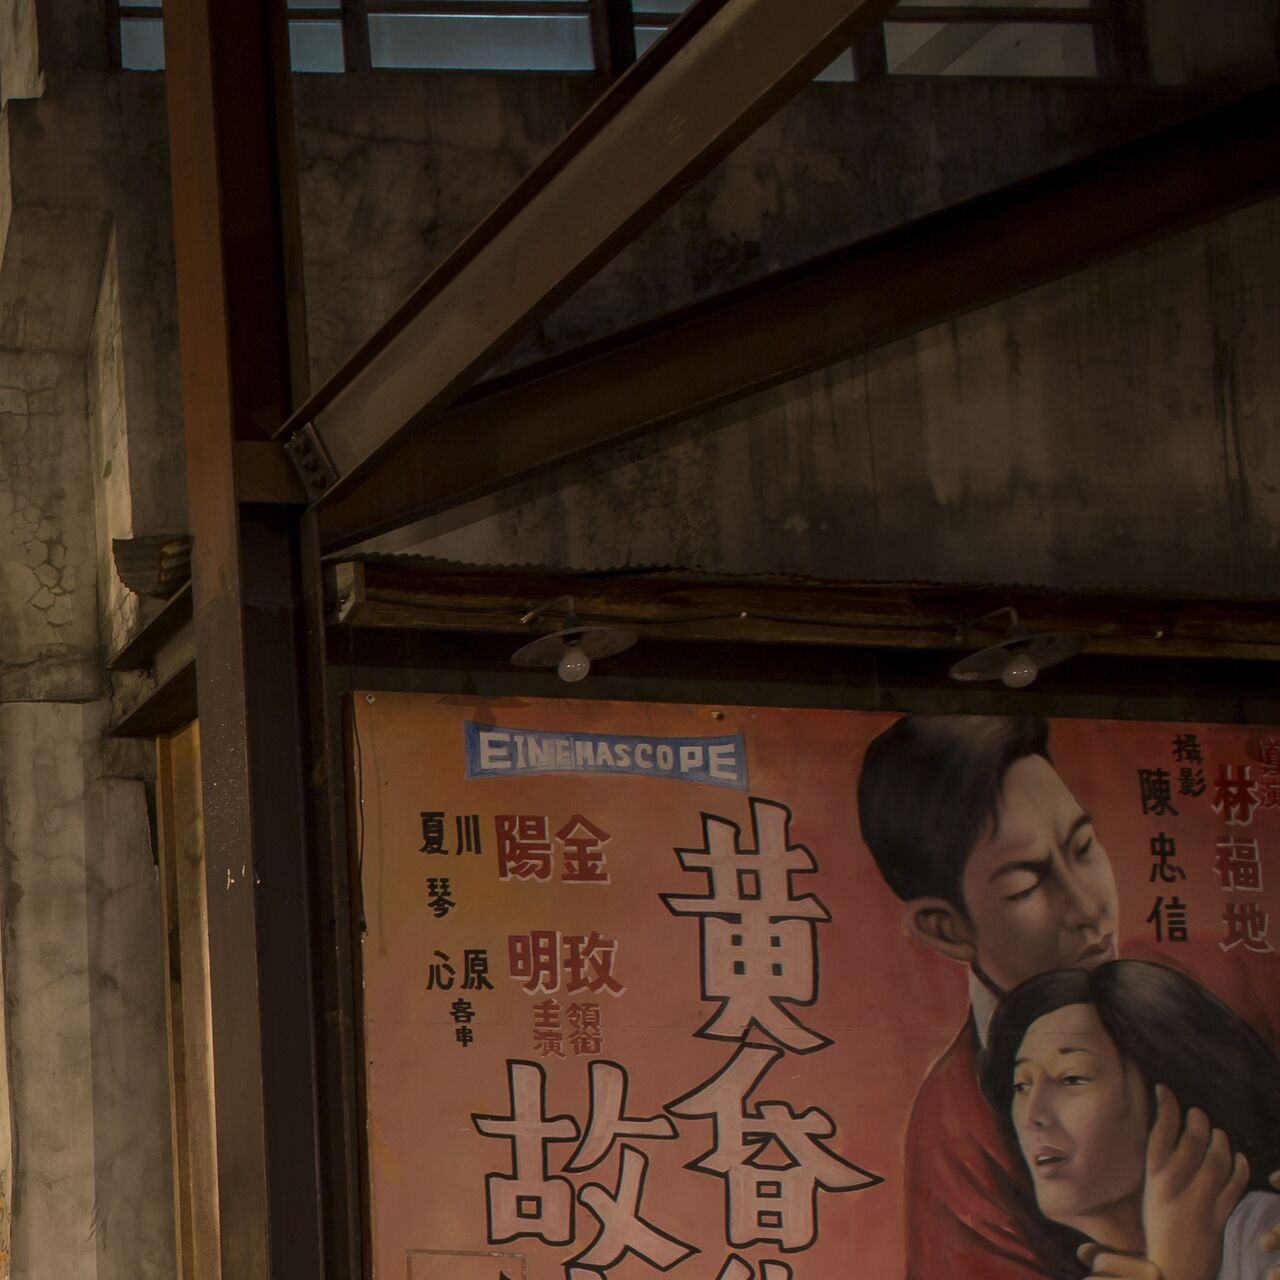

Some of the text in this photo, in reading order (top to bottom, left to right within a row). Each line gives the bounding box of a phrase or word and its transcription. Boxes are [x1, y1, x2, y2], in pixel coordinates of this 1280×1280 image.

[1171, 733, 1208, 797] 攝影
[1137, 768, 1189, 943] 陳忠信
[1210, 764, 1275, 953] 林福地
[449, 998, 475, 1047] 客串
